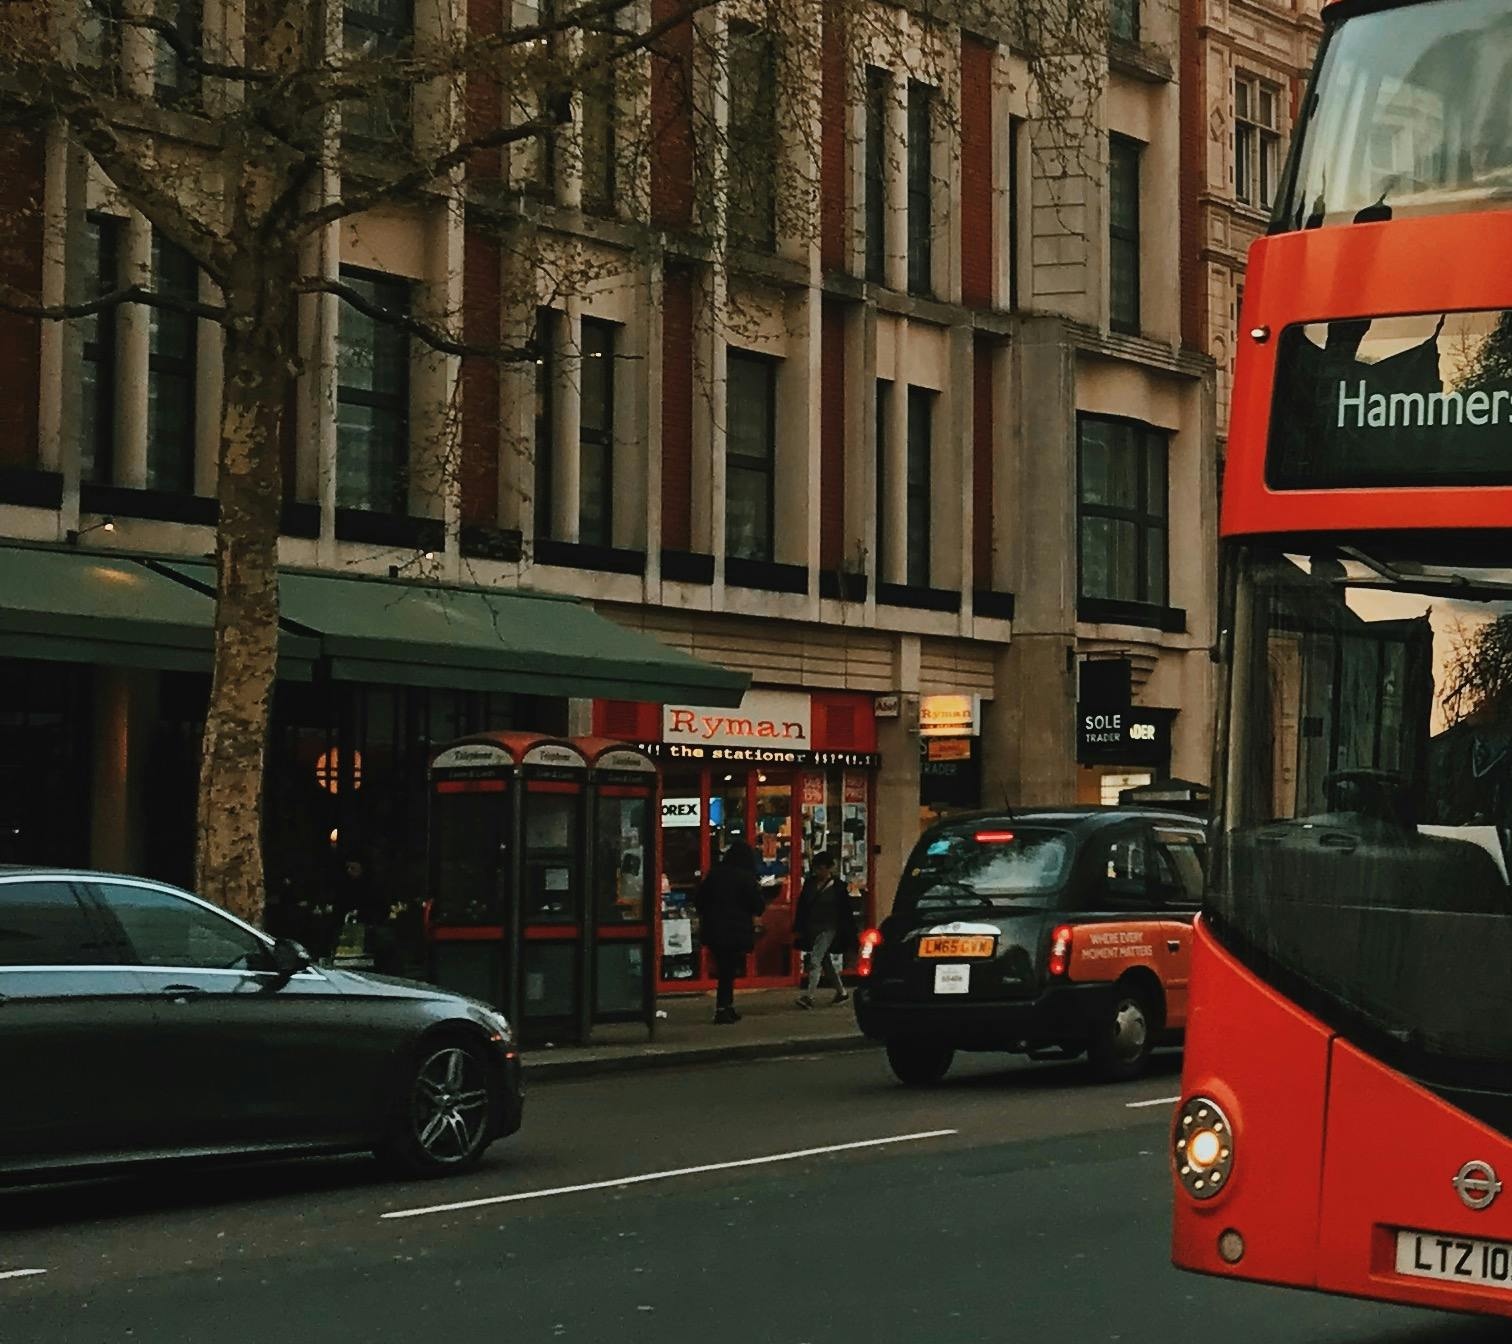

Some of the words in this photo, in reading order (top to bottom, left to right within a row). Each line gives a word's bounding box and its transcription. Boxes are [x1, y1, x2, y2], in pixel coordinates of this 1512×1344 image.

[921, 709, 972, 720] Ryman
[1085, 714, 1121, 730] SOLE
[669, 709, 806, 740] Ryman
[1086, 732, 1121, 743] TRADER
[670, 744, 704, 758] the
[712, 747, 806, 763] stationer
